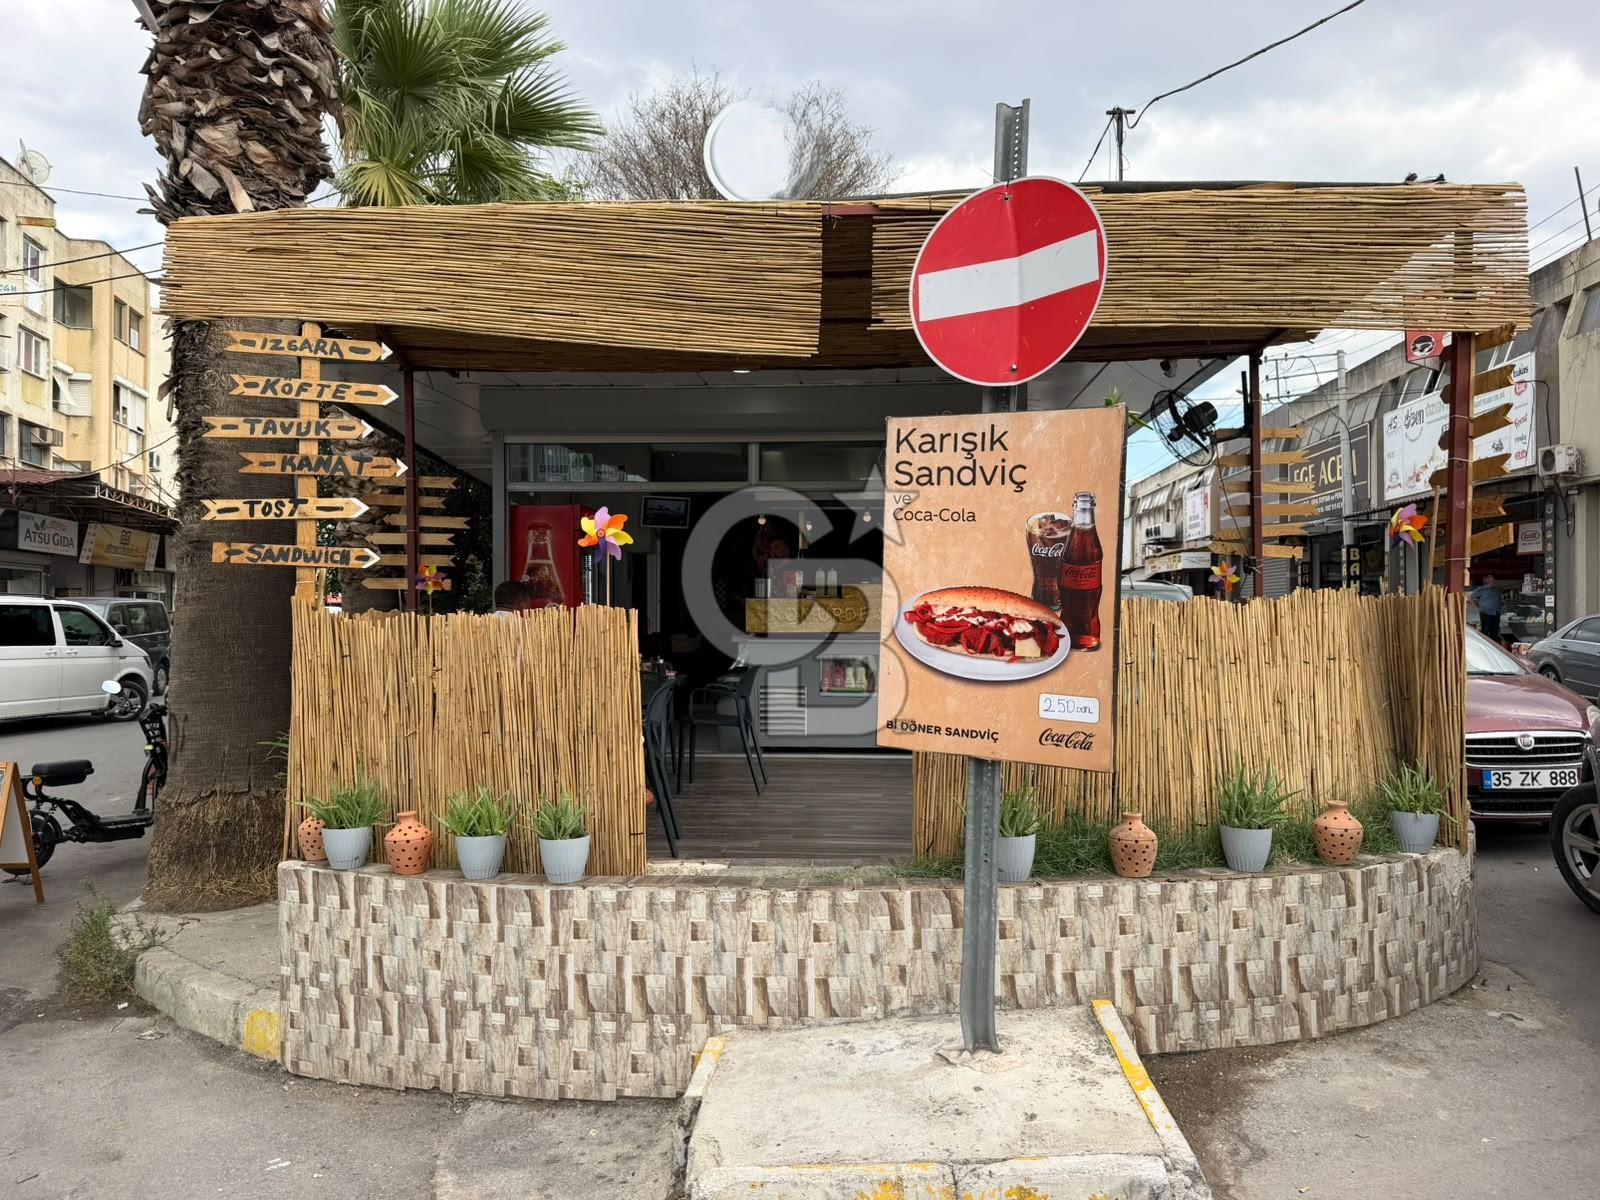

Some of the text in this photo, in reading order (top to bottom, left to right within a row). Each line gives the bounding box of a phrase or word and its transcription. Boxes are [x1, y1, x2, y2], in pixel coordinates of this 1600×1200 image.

[261, 337, 344, 358] IZGARA
[260, 377, 353, 401] KÖFTE
[243, 418, 331, 438] TAVUK
[895, 423, 1009, 460] Karışık
[280, 454, 373, 481] KANAT
[894, 458, 1028, 493] Sandviç
[243, 498, 309, 518] TOST
[893, 494, 912, 505] ve
[892, 507, 977, 522] Coca-Cola
[24, 527, 51, 545] ATSU
[52, 532, 75, 549] GIDA
[900, 721, 943, 737] DÖNER
[944, 726, 999, 743] SANDVİÇ
[1492, 770, 1578, 787] 35 ZK 888
